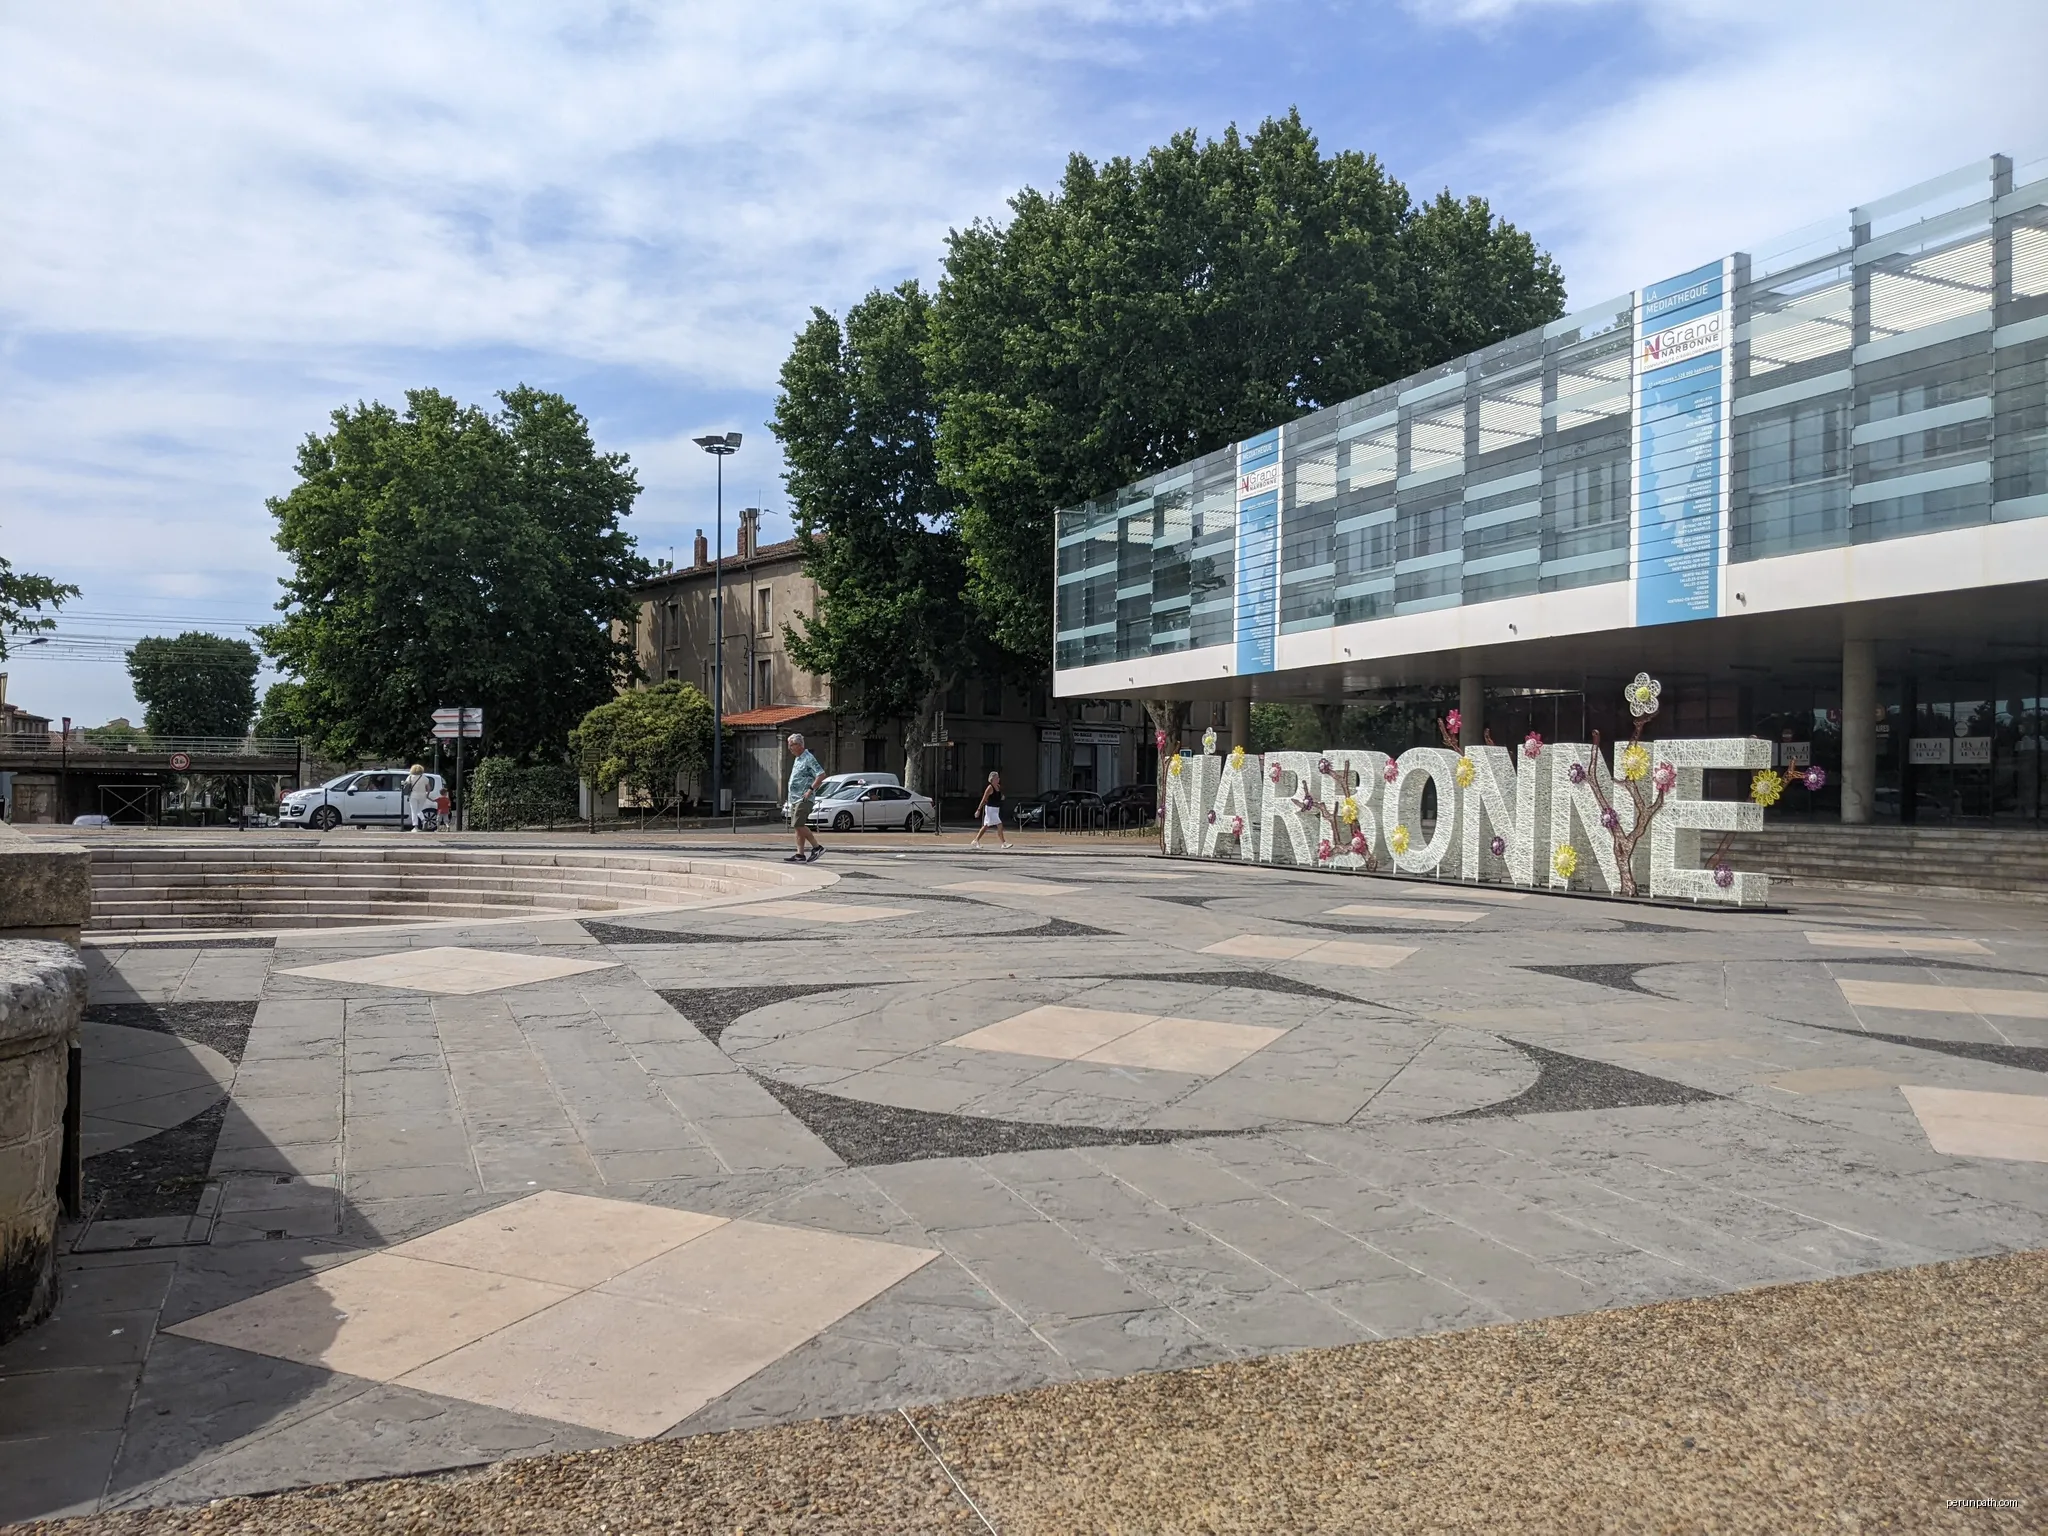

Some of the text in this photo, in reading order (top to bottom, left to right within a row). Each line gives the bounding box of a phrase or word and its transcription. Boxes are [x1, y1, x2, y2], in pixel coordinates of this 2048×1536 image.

[1646, 290, 1657, 302] LA
[1662, 315, 1719, 347] Grand
[1661, 334, 1719, 358] NARBONNE
[1250, 468, 1277, 485] Grand
[1250, 478, 1278, 491] NARBONNE
[1163, 738, 1772, 906] NARBONNE
